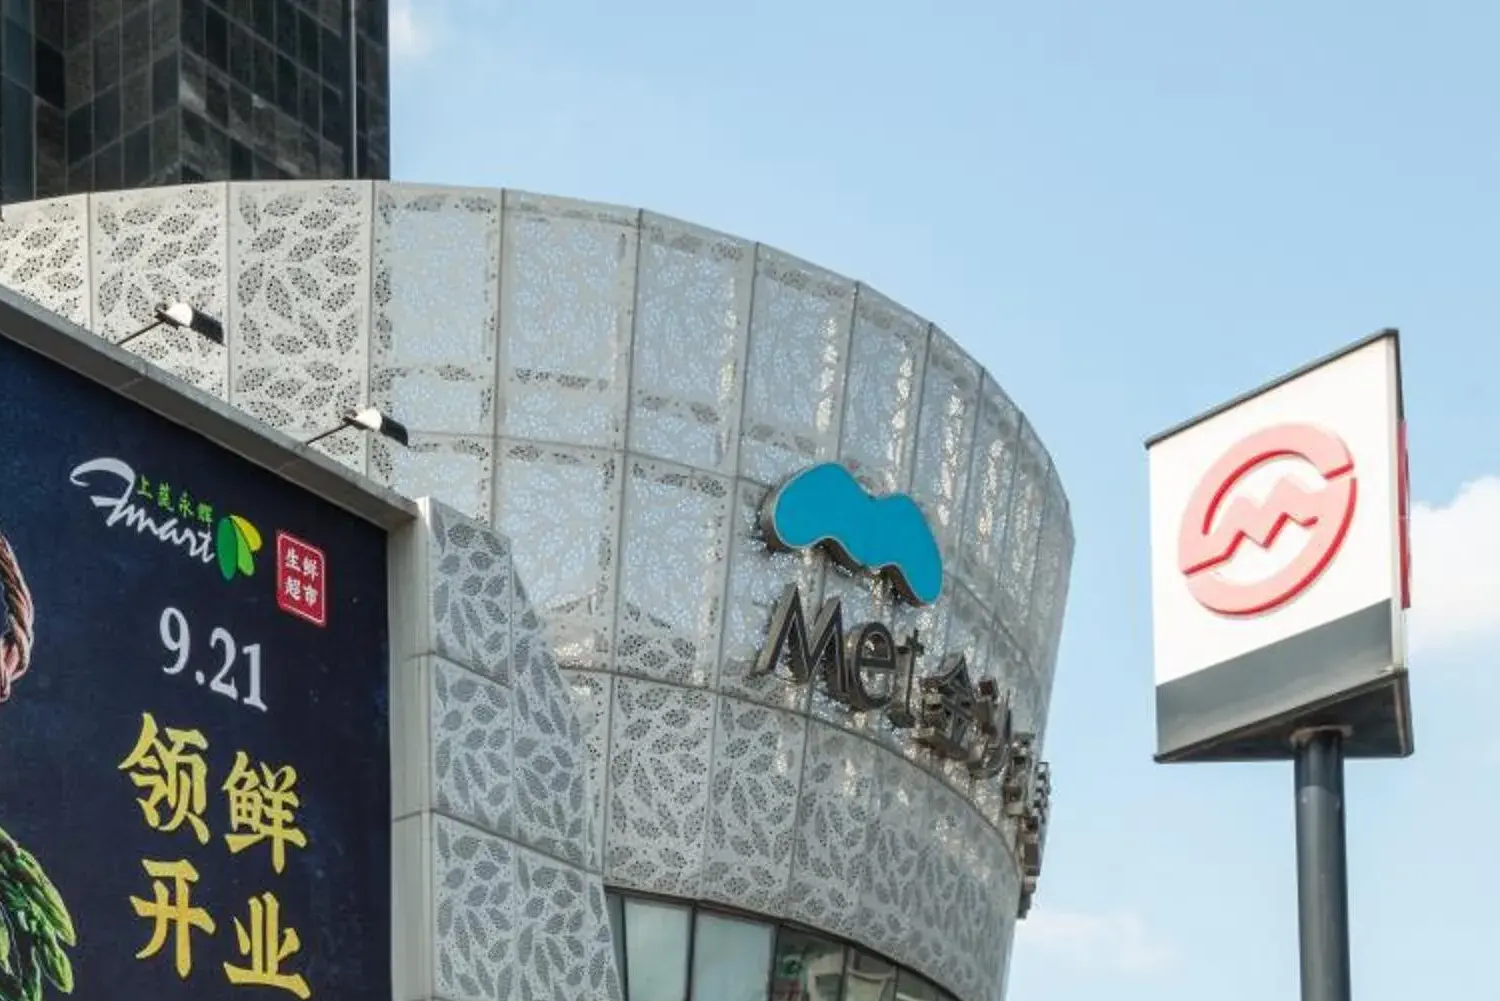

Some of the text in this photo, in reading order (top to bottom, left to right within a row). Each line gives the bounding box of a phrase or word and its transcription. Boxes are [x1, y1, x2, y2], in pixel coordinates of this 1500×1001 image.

[285, 548, 318, 579] 生鲜
[285, 576, 318, 607] 超市
[160, 606, 267, 712] 9.21
[118, 712, 308, 875] 领鲜
[129, 858, 312, 1000] 开业
